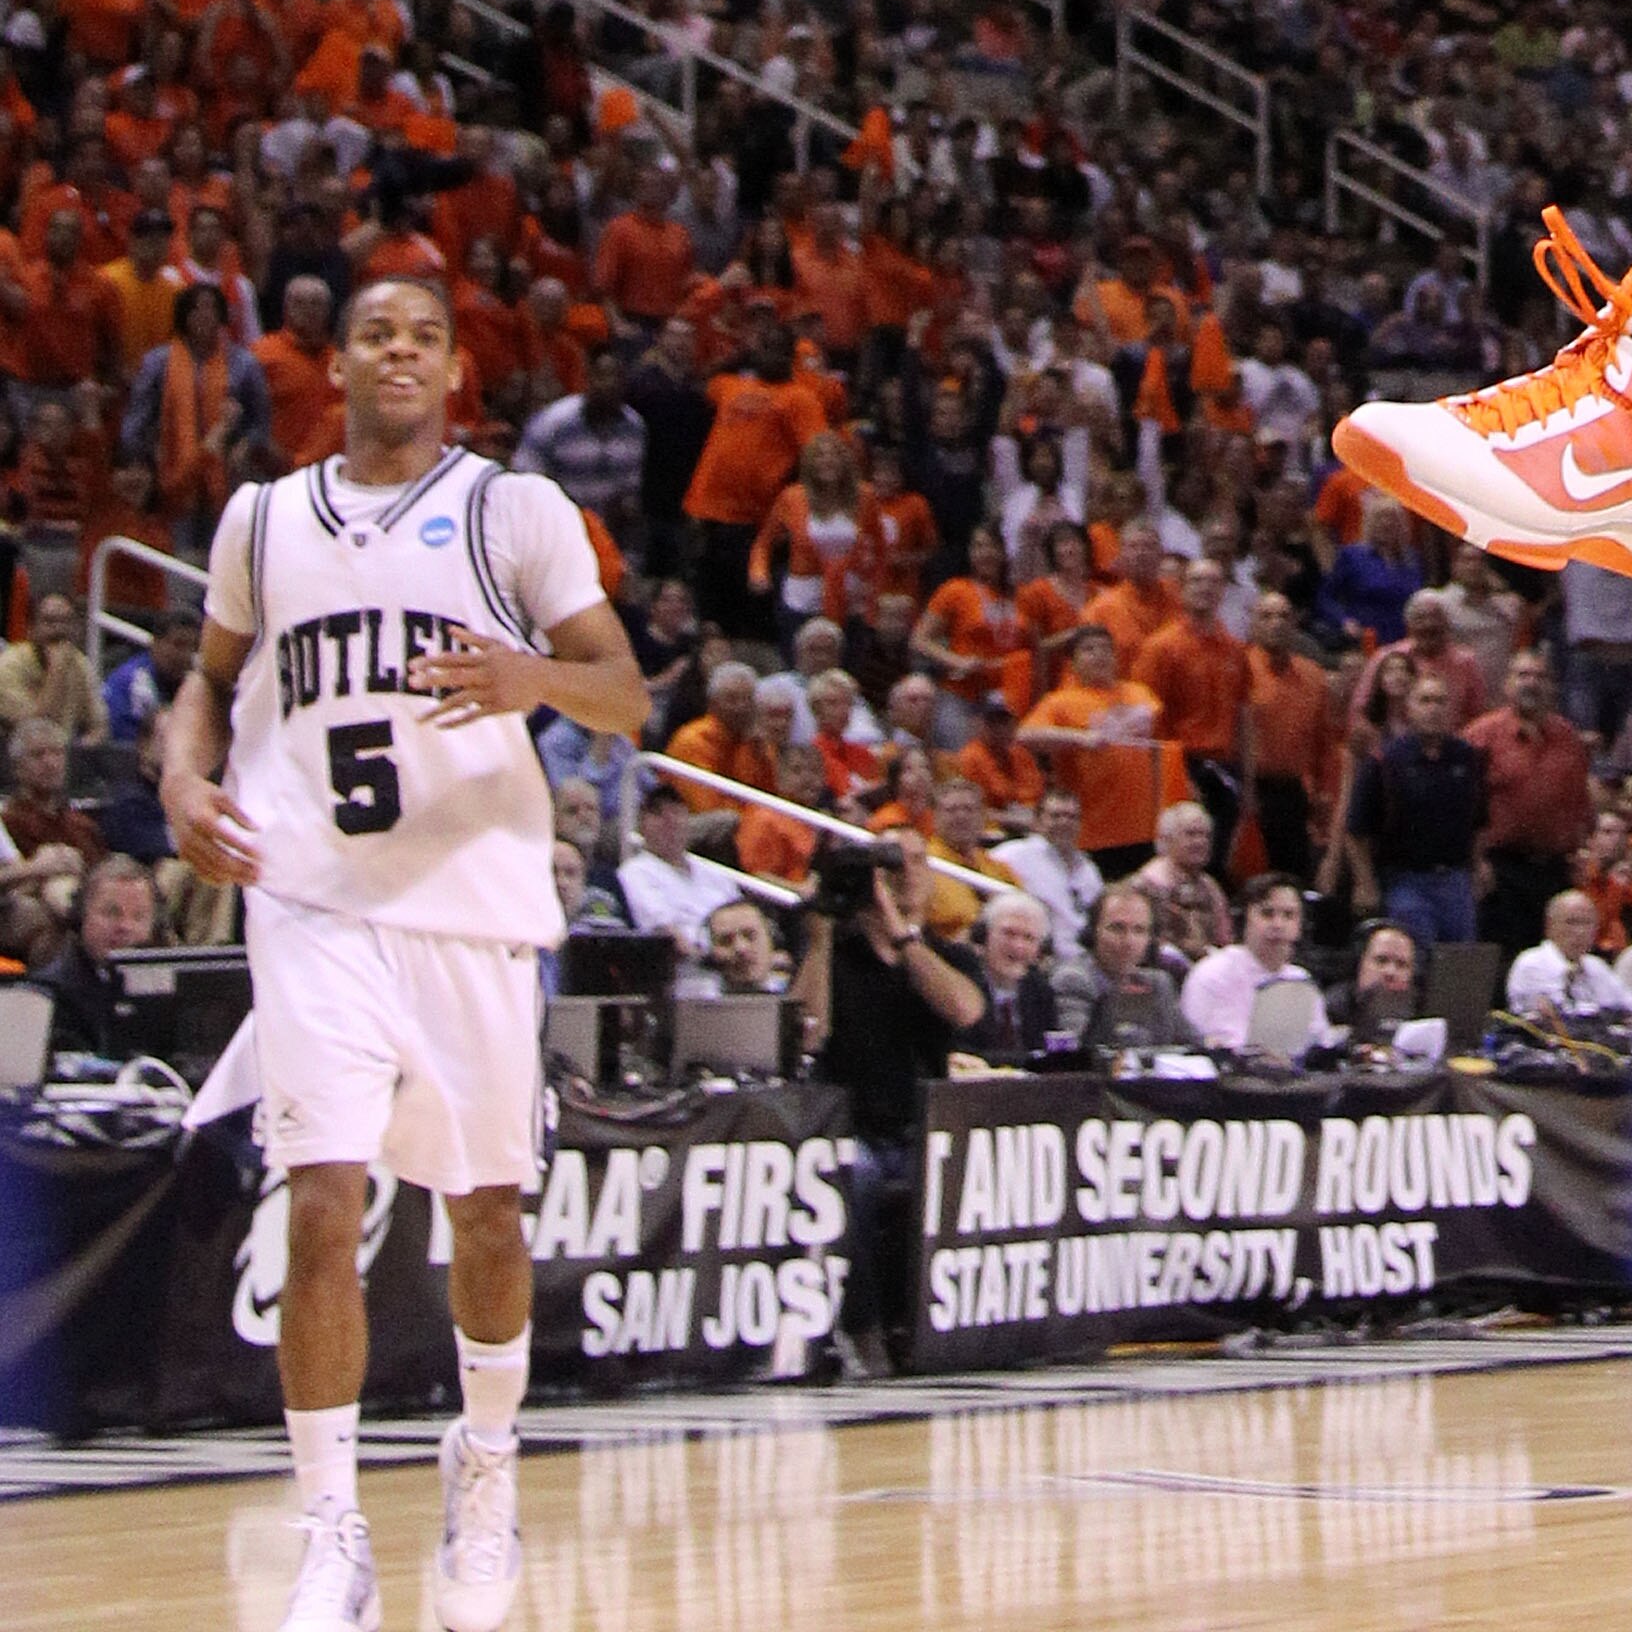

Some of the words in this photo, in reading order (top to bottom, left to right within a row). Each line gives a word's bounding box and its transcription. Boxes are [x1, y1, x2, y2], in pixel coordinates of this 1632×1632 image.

[327, 720, 401, 836] 5
[957, 1122, 1065, 1235] AND
[1076, 1119, 1306, 1222] SECOND
[1316, 1114, 1536, 1215] ROUNDS
[582, 1267, 696, 1357] SAN
[930, 1239, 1051, 1333] STATE
[1056, 1228, 1311, 1316] UNIVERSITY,
[1322, 1221, 1439, 1300] HOST
